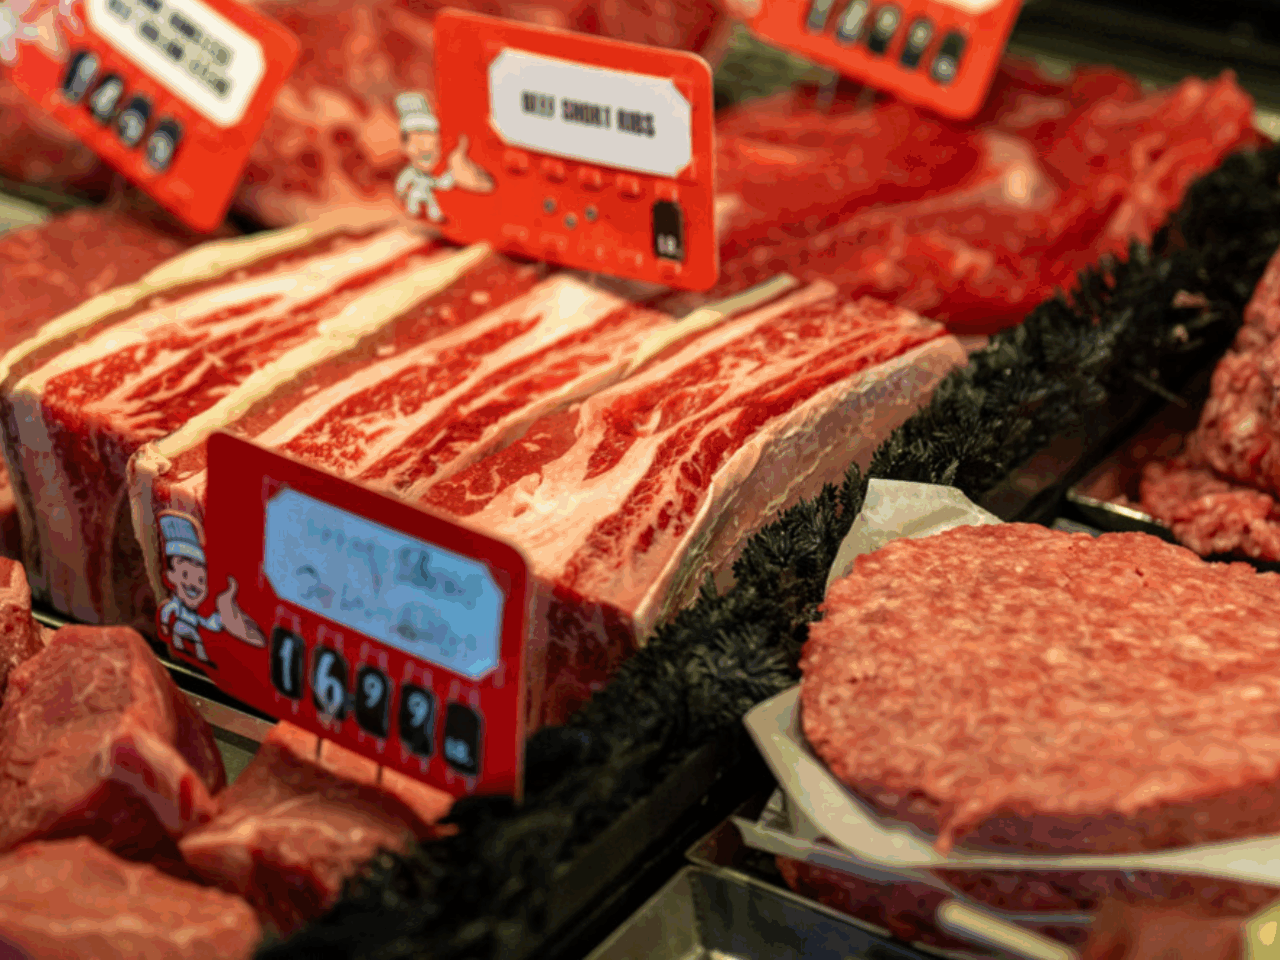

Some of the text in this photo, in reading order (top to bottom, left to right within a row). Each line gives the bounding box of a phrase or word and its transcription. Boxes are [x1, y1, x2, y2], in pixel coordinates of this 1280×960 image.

[521, 90, 656, 139] BEEF SHORT RIBS
